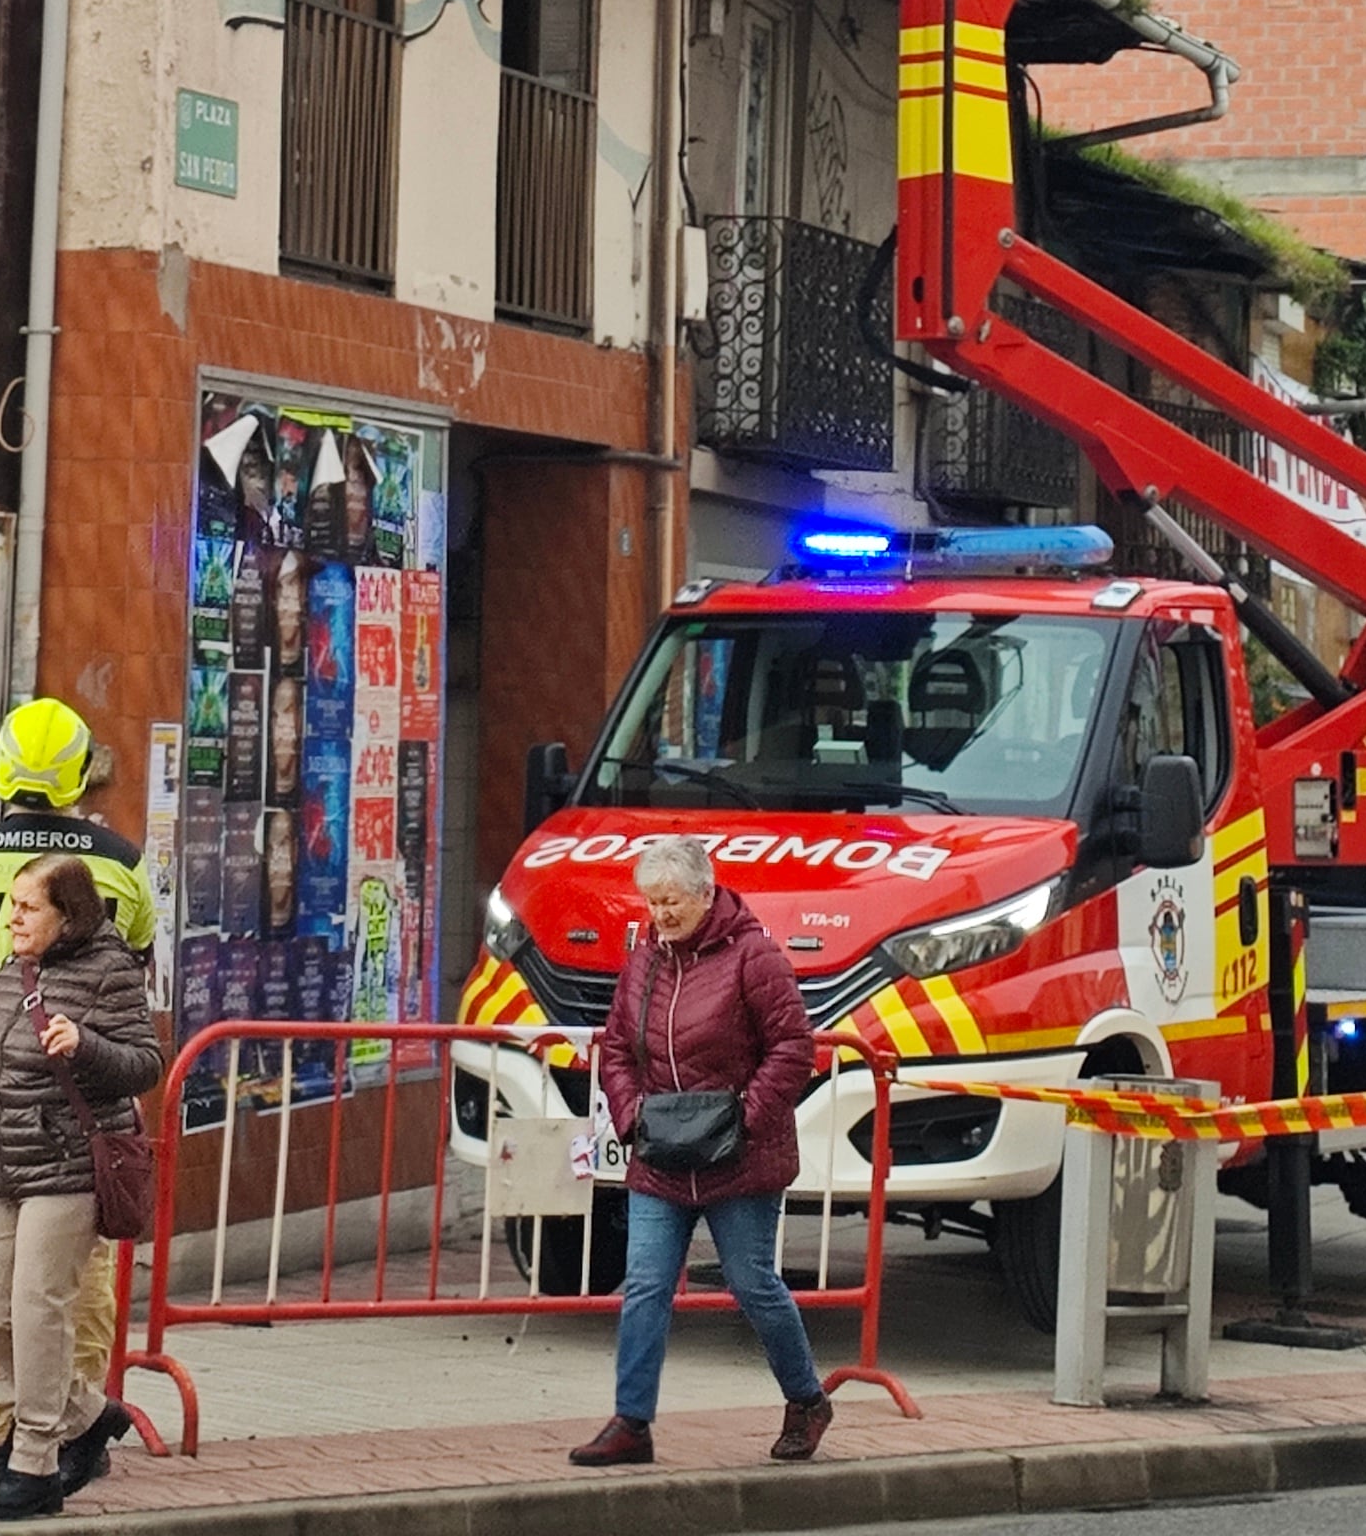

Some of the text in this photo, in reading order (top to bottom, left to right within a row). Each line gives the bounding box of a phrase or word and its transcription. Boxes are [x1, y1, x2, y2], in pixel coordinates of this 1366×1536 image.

[196, 100, 232, 127] PLAZA
[179, 151, 235, 190] SAN PEDRO
[801, 913, 850, 928] VTA-01
[1232, 949, 1258, 990] 112
